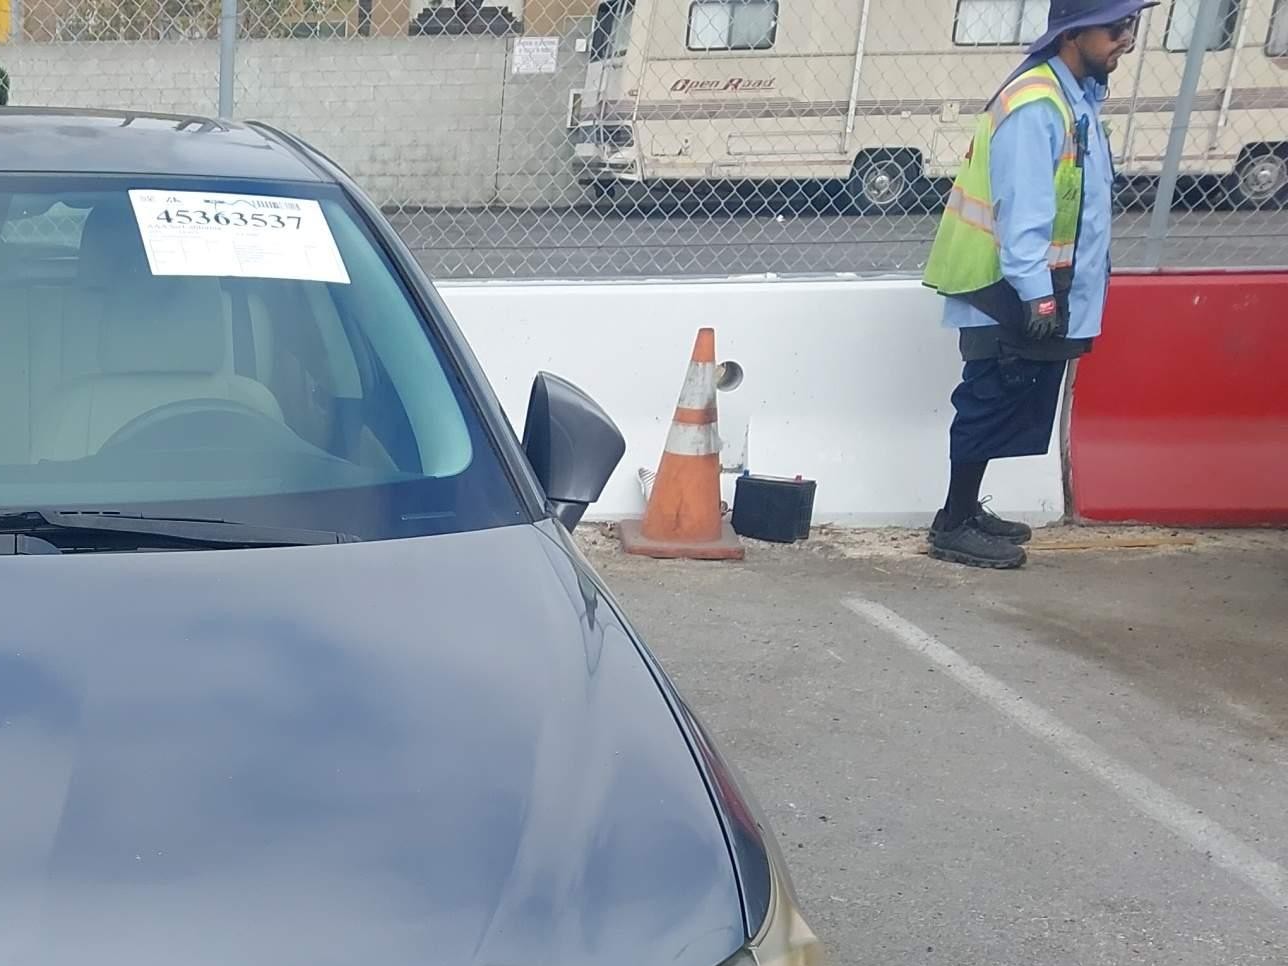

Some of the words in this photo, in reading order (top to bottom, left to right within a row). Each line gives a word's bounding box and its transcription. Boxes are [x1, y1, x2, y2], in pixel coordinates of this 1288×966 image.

[671, 79, 720, 93] Open
[723, 77, 775, 90] Road
[156, 209, 302, 230] 45363537
